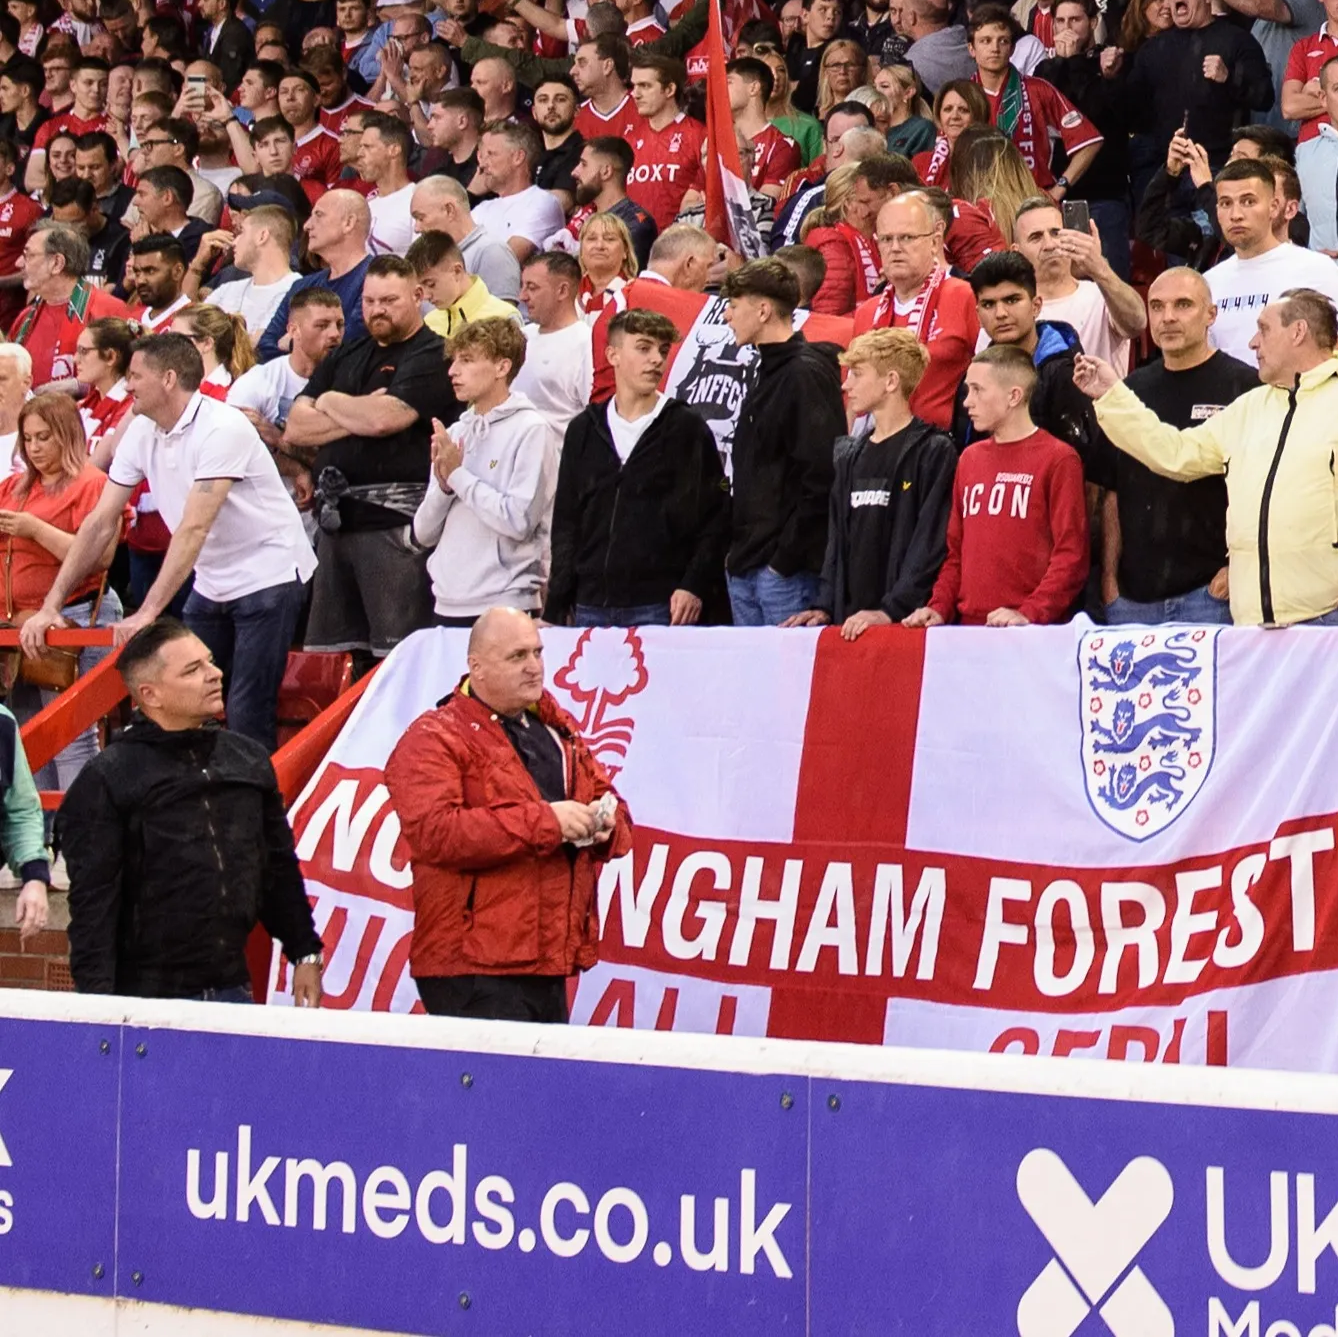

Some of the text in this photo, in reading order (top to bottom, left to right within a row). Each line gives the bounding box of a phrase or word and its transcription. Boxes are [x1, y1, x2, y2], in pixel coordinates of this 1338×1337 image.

[700, 296, 726, 323] RE
[962, 484, 1031, 520] ICON
[297, 778, 946, 981] NONGHAM
[973, 827, 1337, 996] FOREST
[185, 1124, 794, 1279] ukmeds.co.uk
